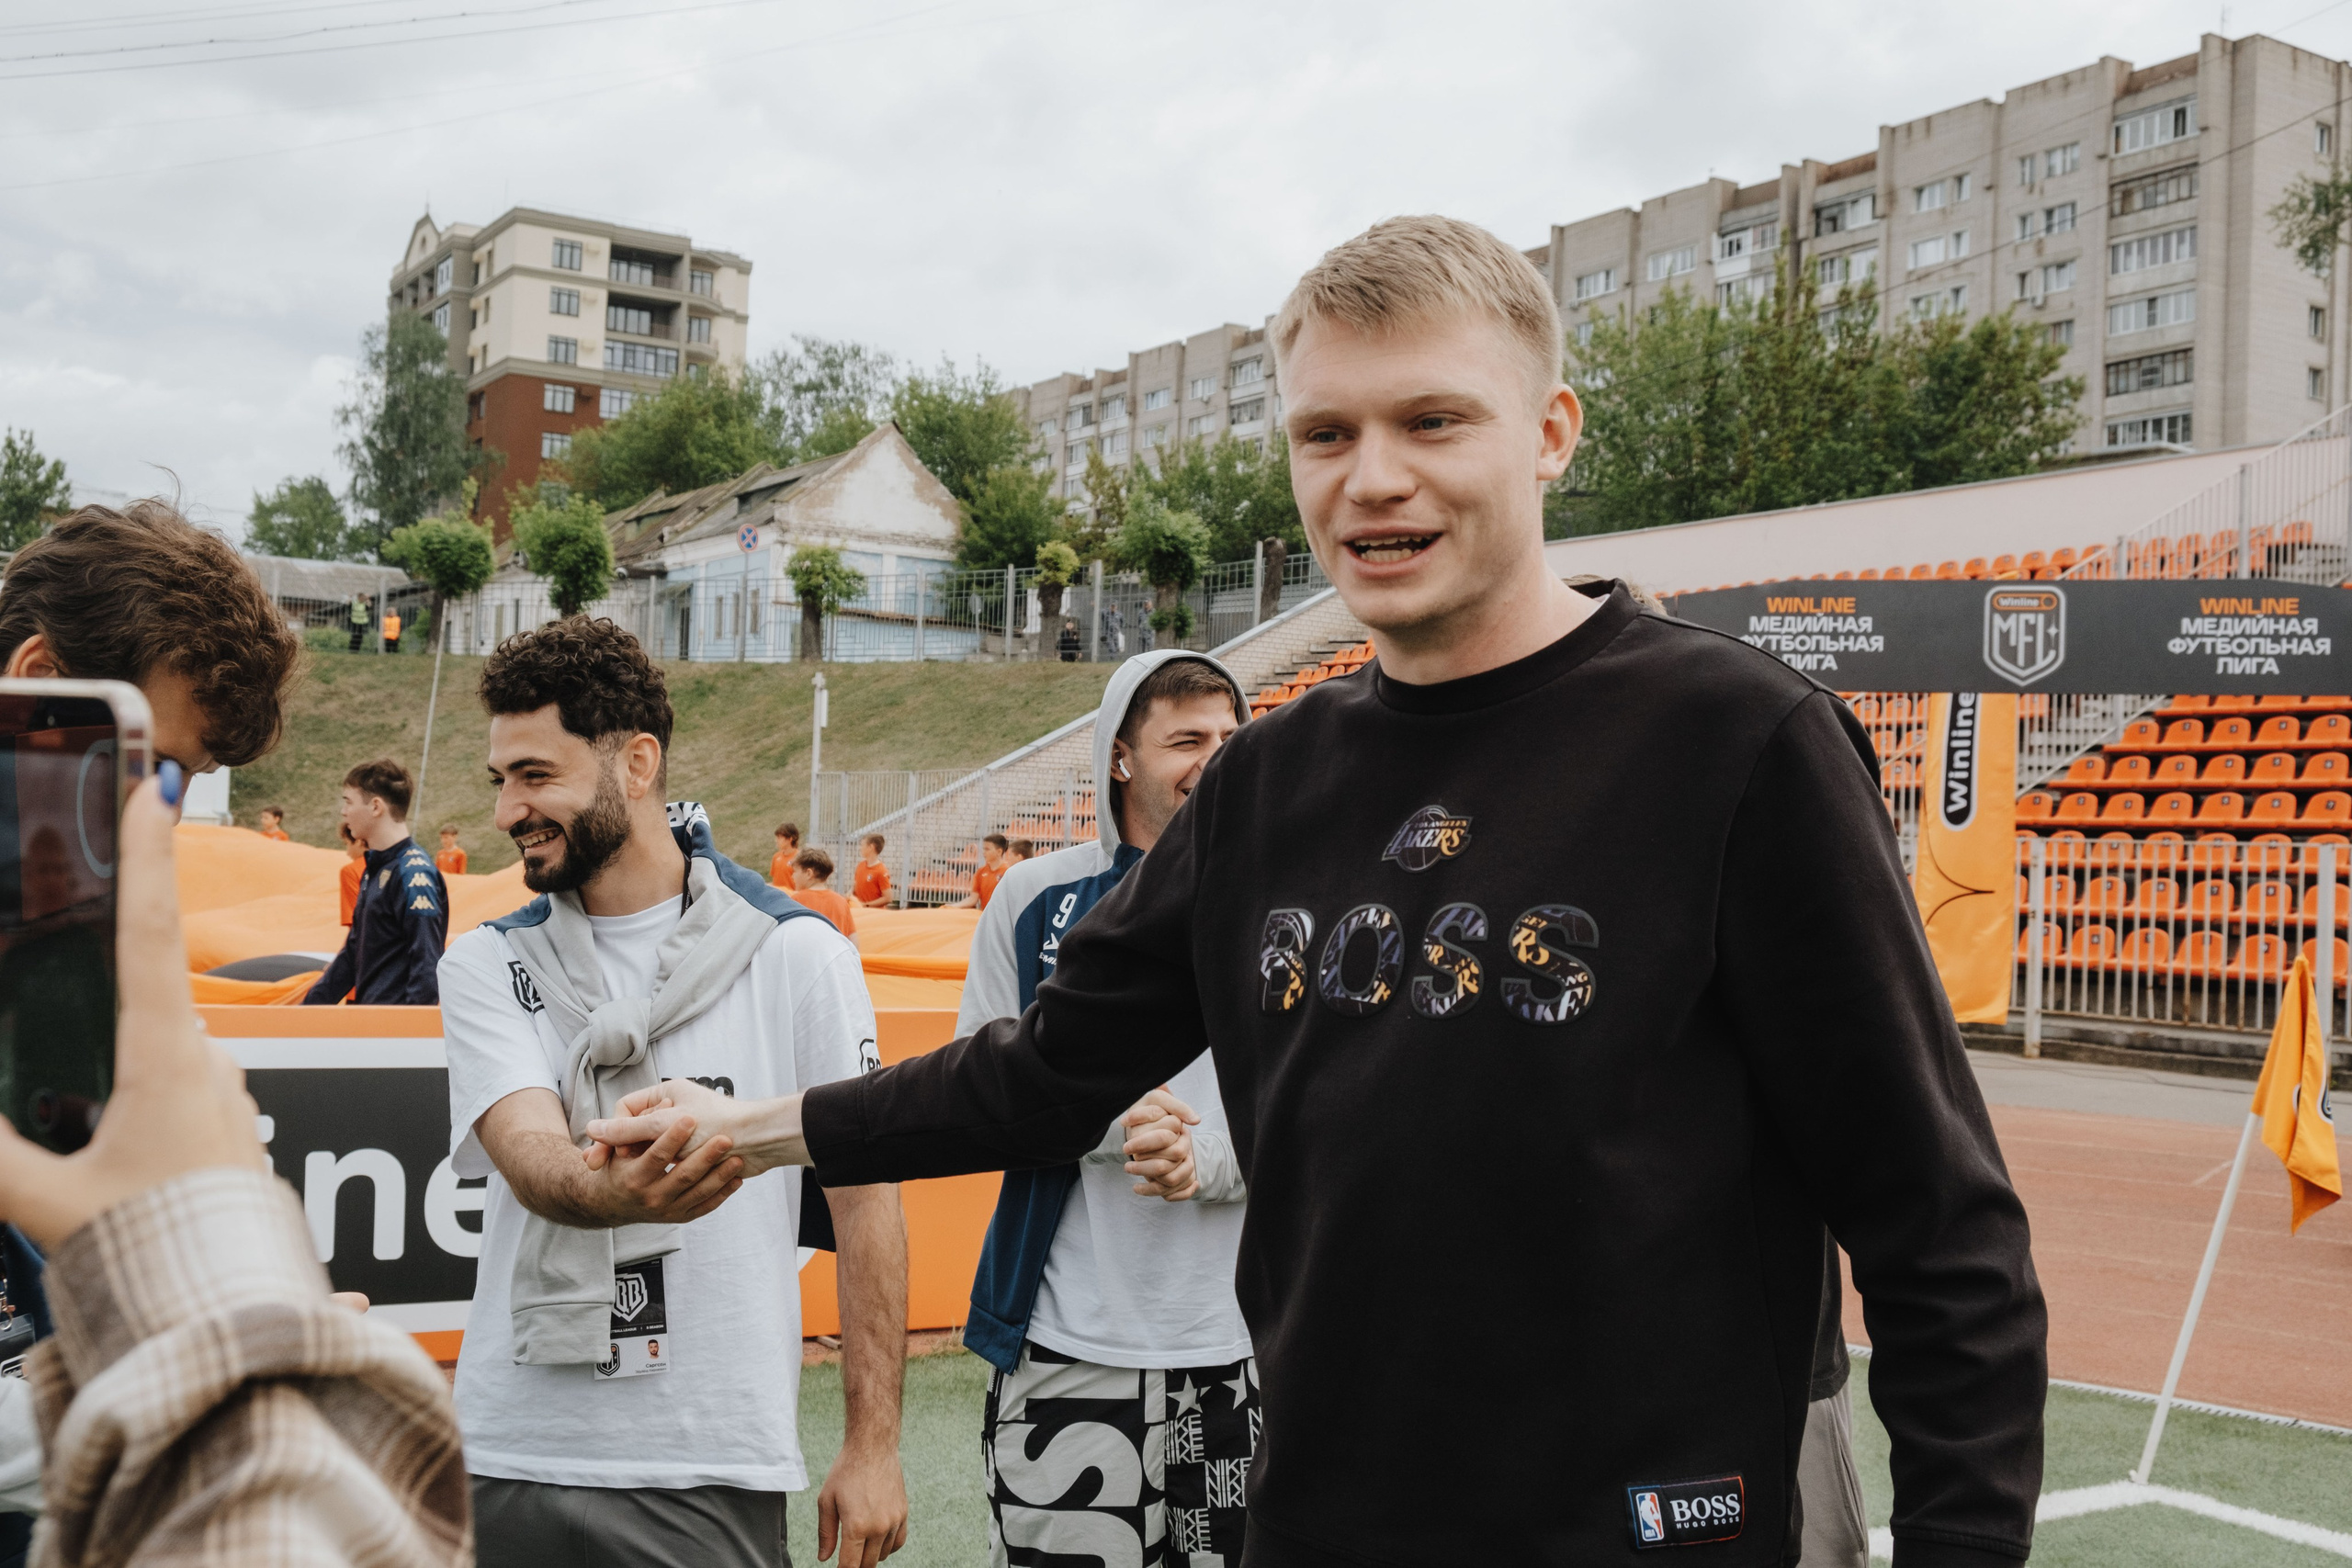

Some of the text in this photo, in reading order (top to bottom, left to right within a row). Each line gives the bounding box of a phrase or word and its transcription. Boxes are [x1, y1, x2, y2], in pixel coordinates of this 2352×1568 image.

[1766, 596, 1856, 614] WINLINE
[2199, 598, 2300, 615] WINLINE
[1749, 613, 1873, 634] МЕДИЙНАЯ
[2181, 615, 2318, 637] МЕДИЙНАЯ
[2167, 637, 2332, 655] ФУТБОЛЬНАЯ
[2216, 656, 2280, 675] ЛИГА
[1387, 824, 1465, 856] LAKERS
[1052, 893, 1077, 929] 9
[1259, 903, 1600, 1026] BOSS
[1670, 1494, 1740, 1521] BOSS
[1677, 1516, 1739, 1529] HUGO BOSS
